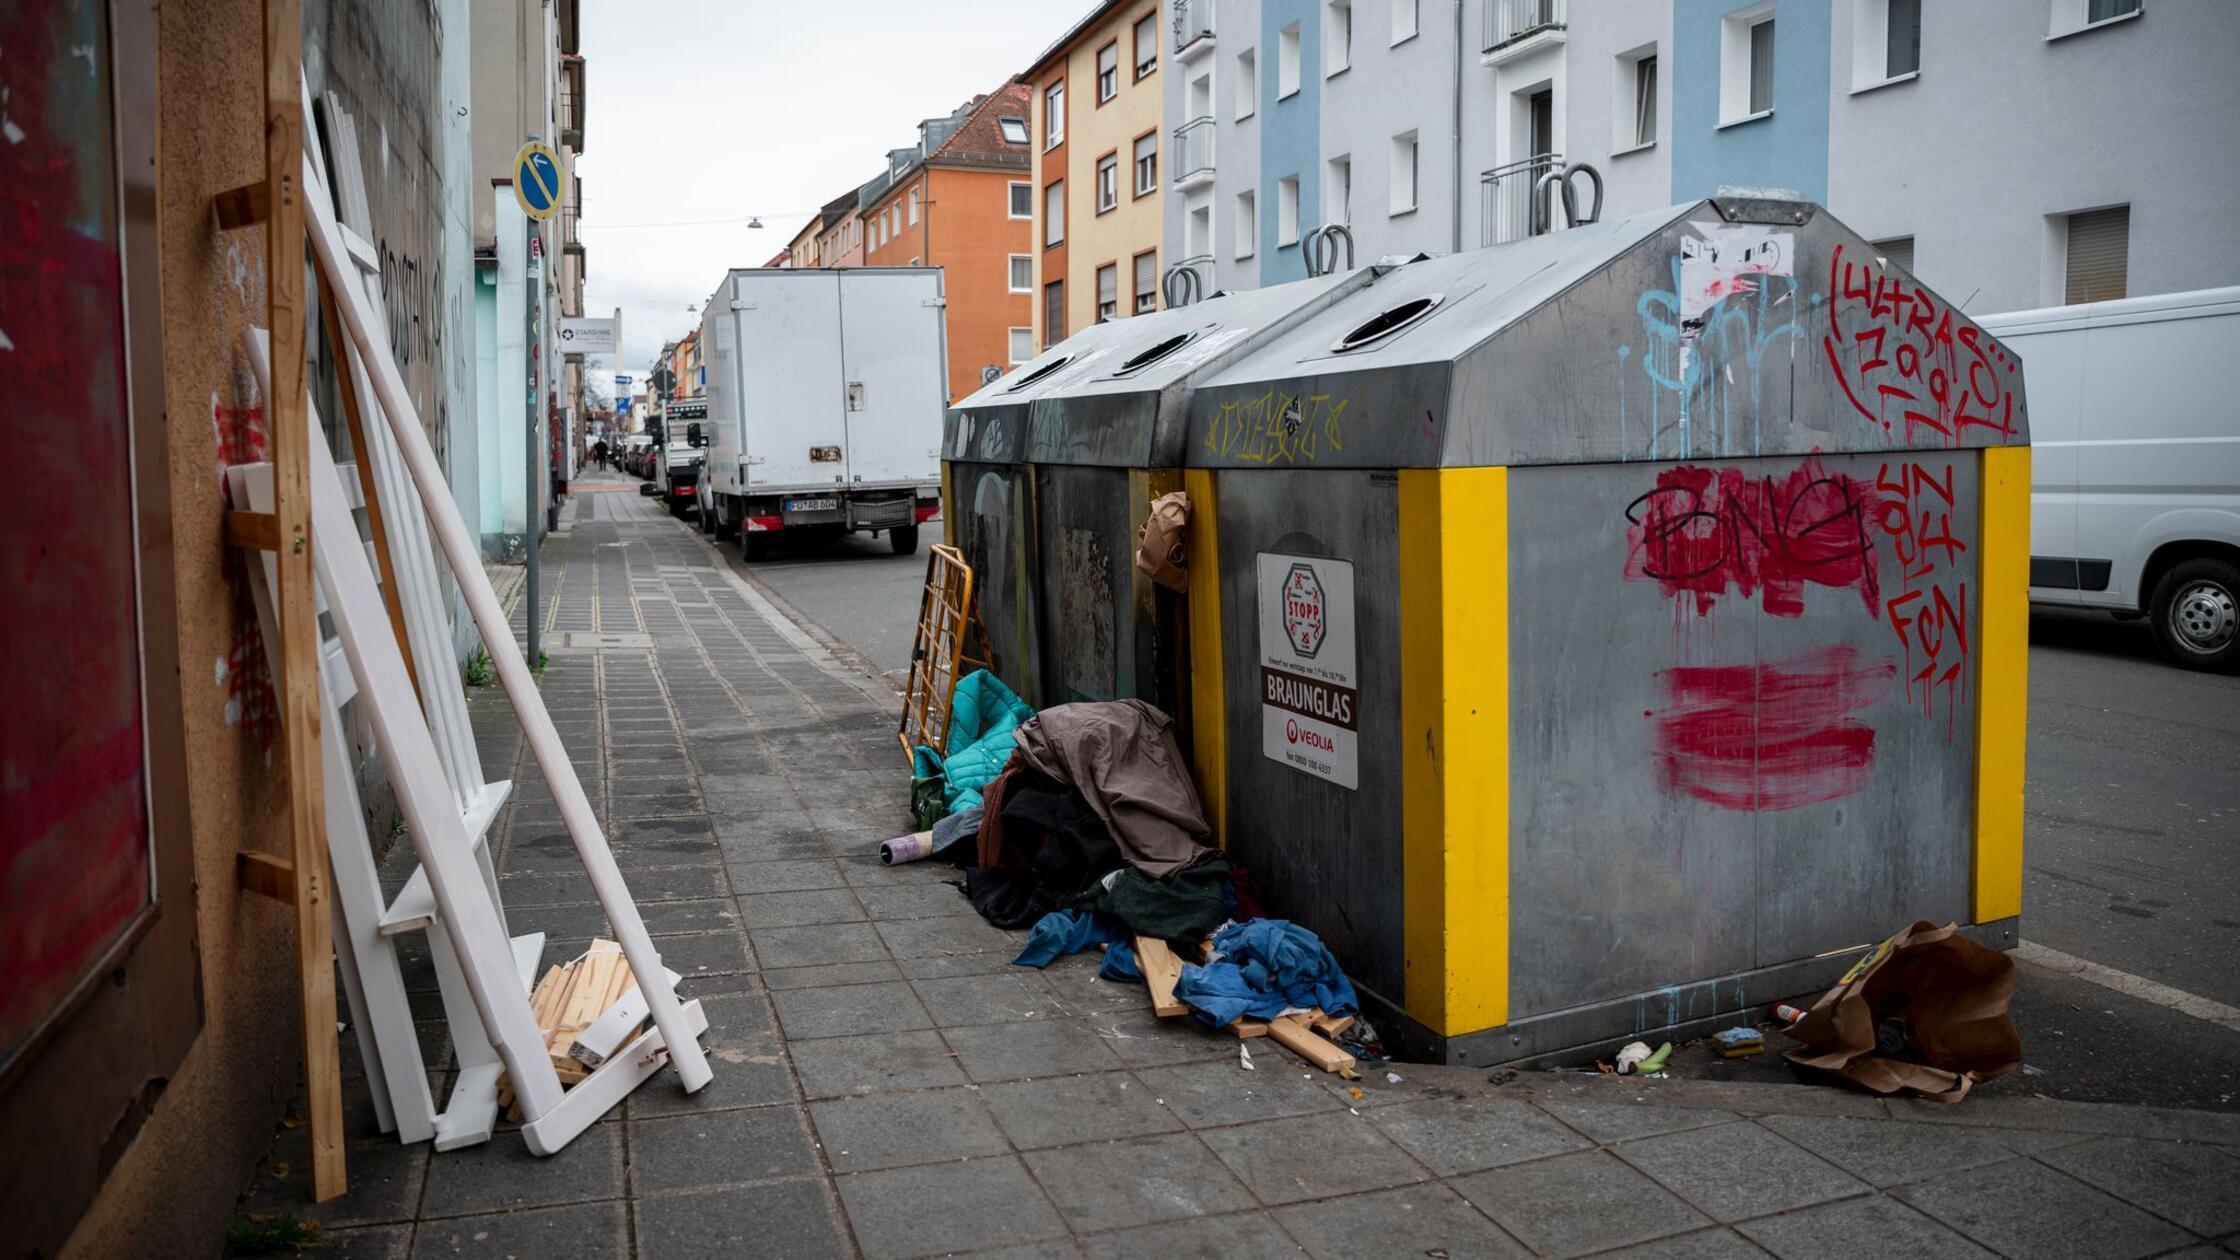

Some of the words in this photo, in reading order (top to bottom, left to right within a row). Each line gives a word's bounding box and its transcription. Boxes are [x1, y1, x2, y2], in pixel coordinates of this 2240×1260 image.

[1843, 261, 1999, 409] ULTRAS
[1877, 463, 1955, 507] UN
[1288, 601, 1319, 621] STOPP
[1886, 582, 1968, 659] FCN
[1267, 674, 1351, 724] BRAUNGLAS
[1299, 728, 1334, 752] VEOLIA
